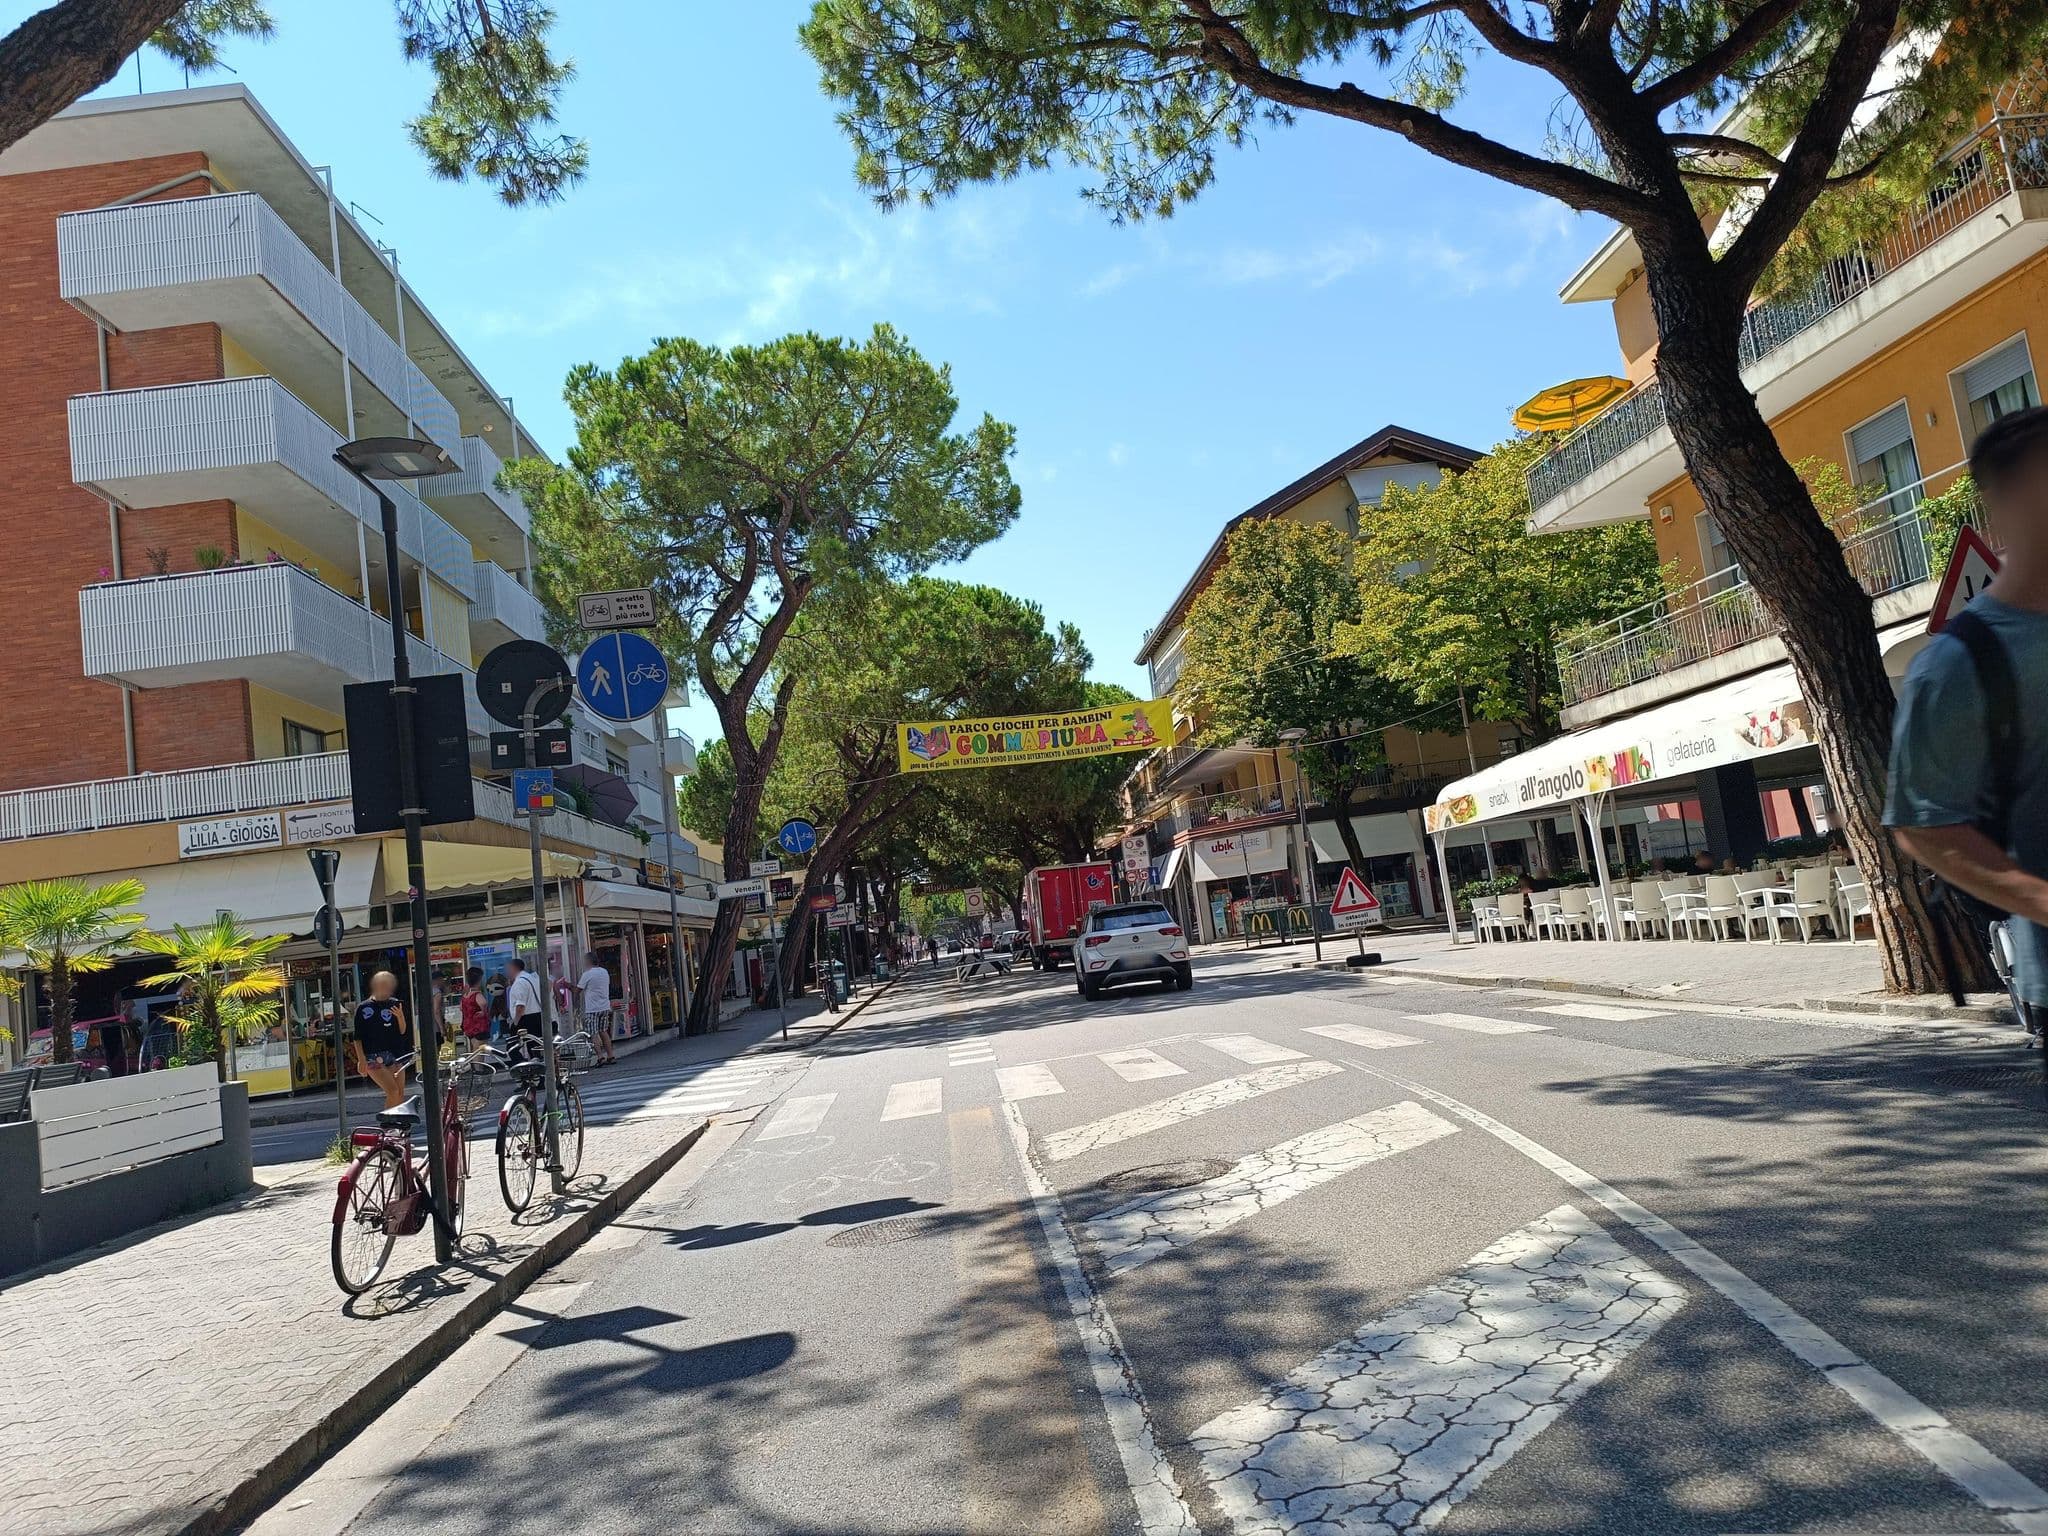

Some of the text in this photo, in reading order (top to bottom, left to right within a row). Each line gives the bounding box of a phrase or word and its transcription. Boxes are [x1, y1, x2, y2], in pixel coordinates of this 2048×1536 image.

[949, 711, 1112, 734] PARCO GIOCHI PER BAMBINI
[956, 723, 1108, 755] GOMMAPIUMA
[1667, 735, 1716, 767] gelateria
[1520, 765, 1584, 802] all'angolo
[1489, 790, 1509, 808] snack
[320, 810, 344, 818] FRONTE
[190, 818, 253, 833] HOTELS
[190, 831, 219, 848] LILIA
[230, 824, 279, 844] GIOIOSA
[1211, 839, 1234, 855] ubik
[734, 885, 762, 893] Venezia
